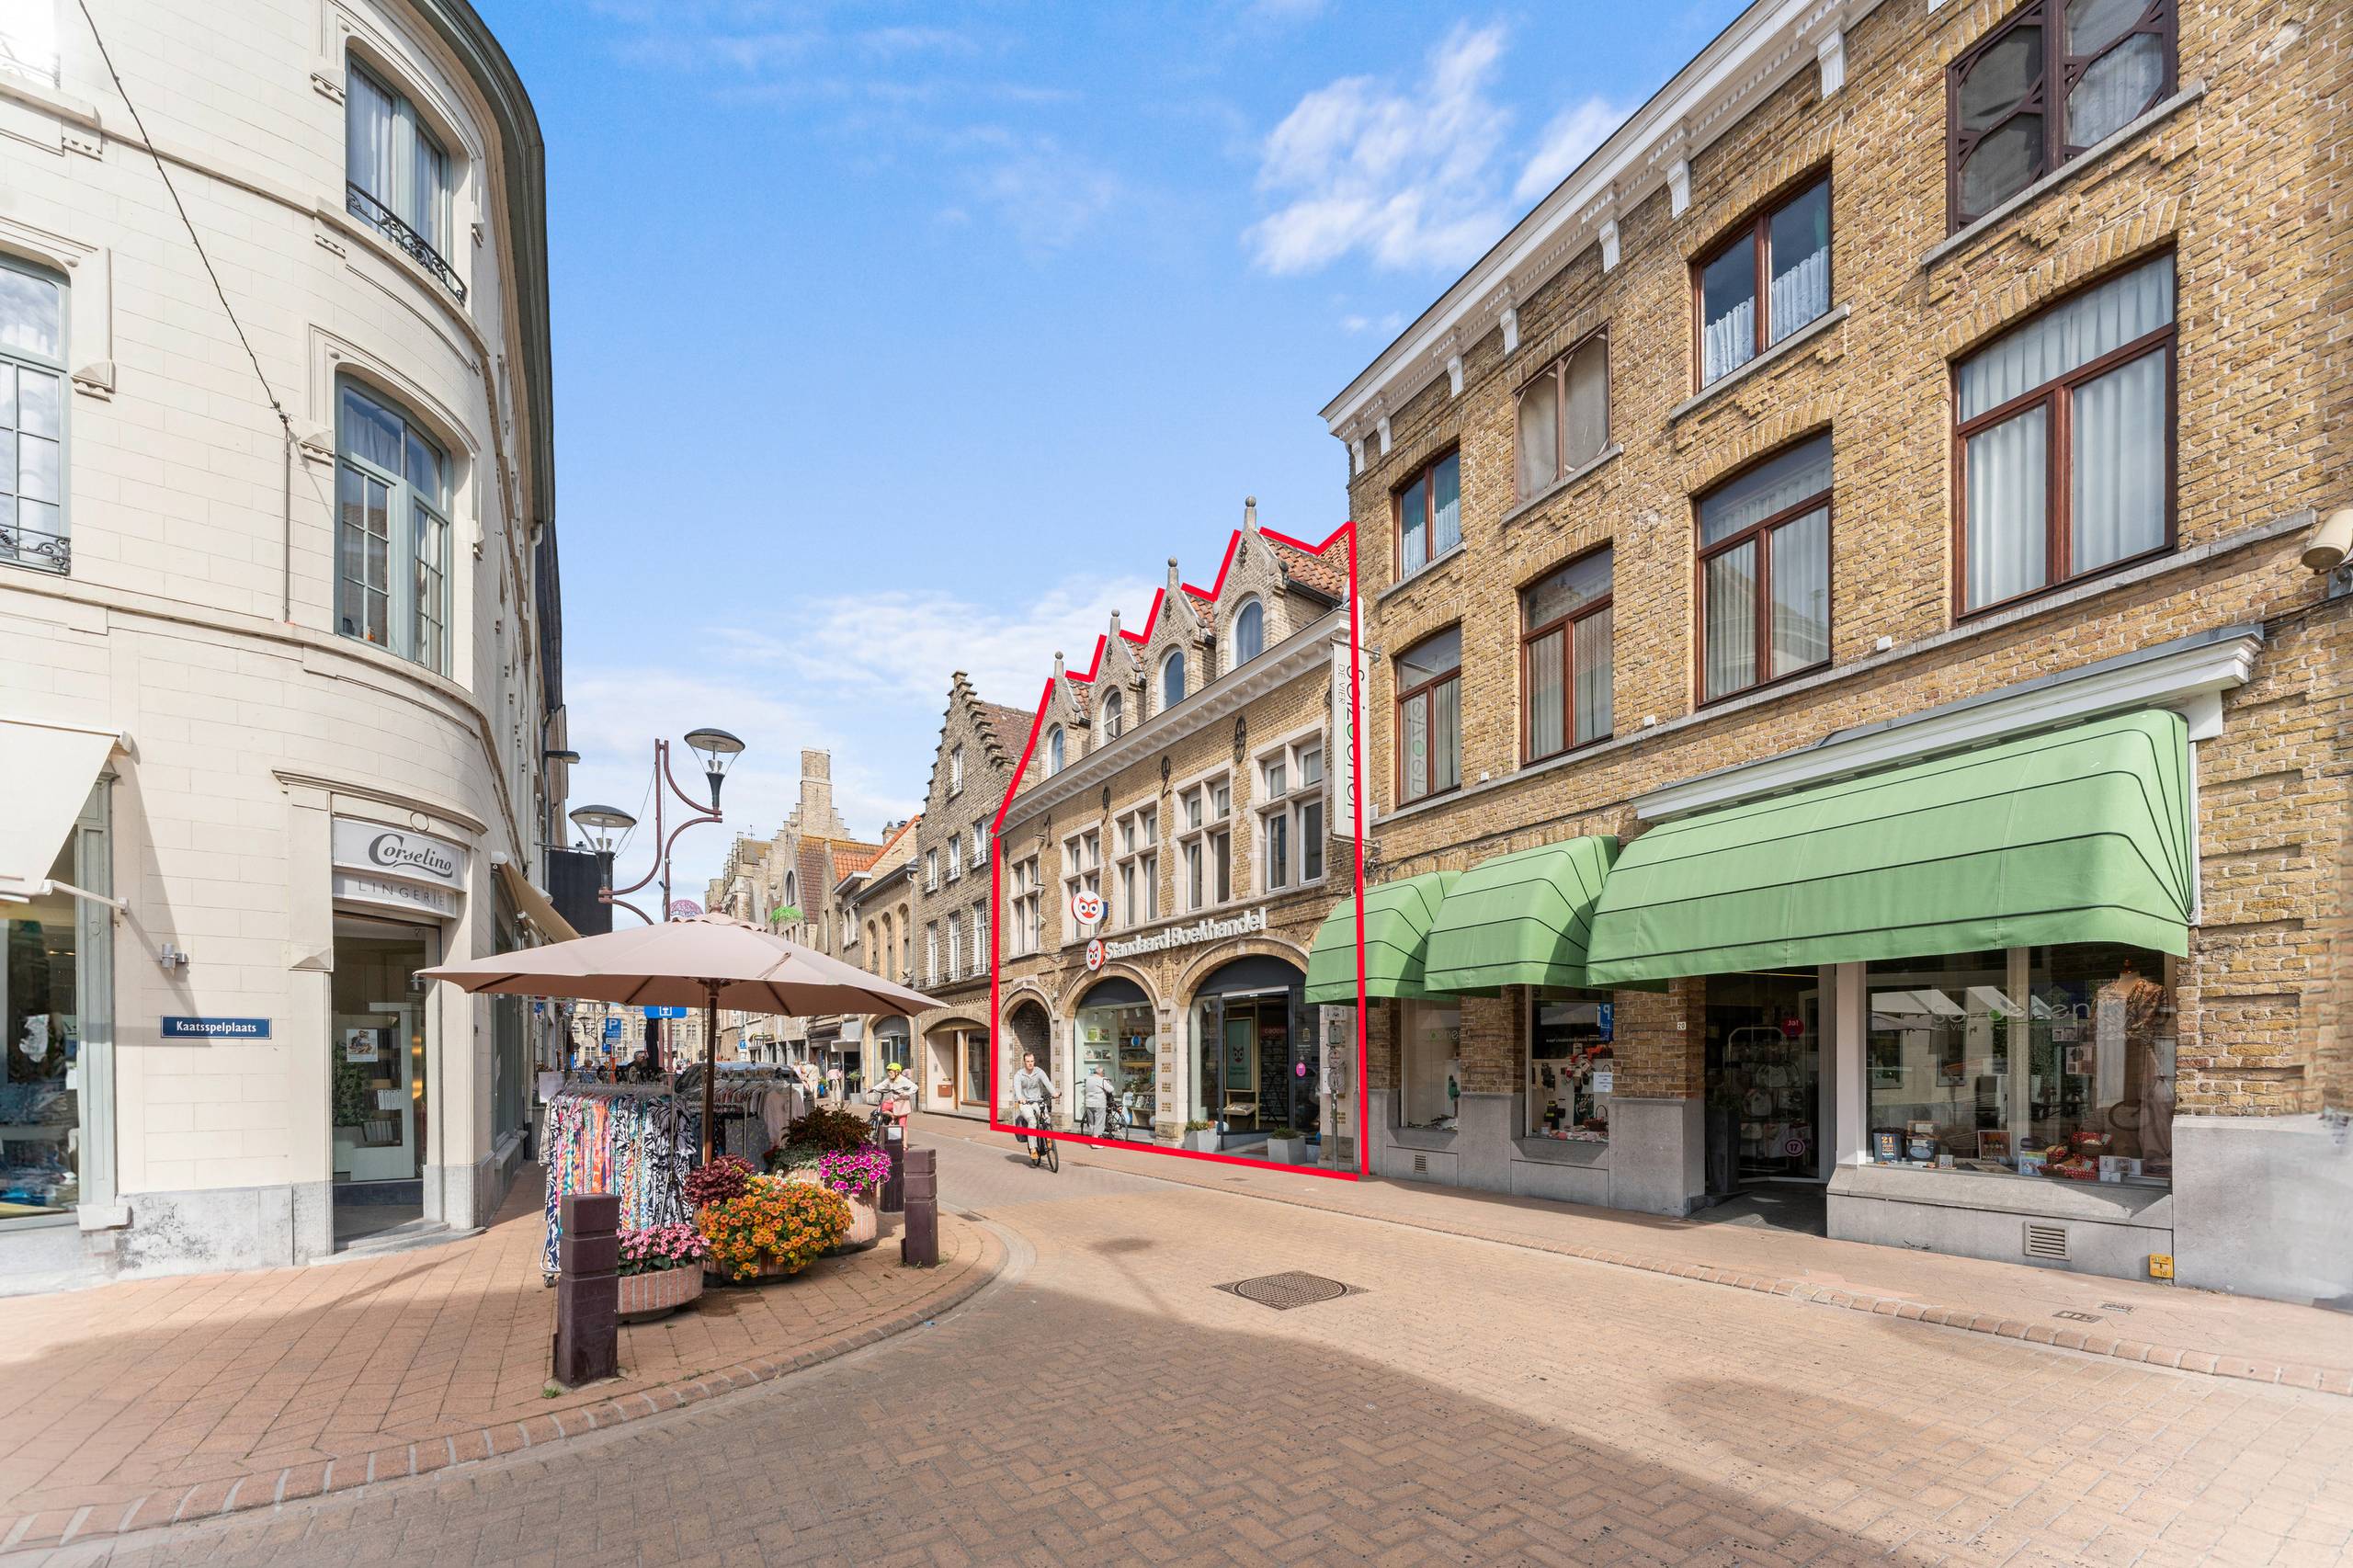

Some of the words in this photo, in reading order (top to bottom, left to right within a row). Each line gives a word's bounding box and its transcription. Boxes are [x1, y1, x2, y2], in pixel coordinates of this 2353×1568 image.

[1337, 664, 1345, 679] DE
[369, 834, 453, 878] Corselino
[358, 881, 445, 906] LINGERIE
[1105, 928, 1170, 960] Standaard
[1170, 906, 1267, 946] Boekhandel
[176, 1021, 256, 1034] Kaatsspelplaats
[608, 1019, 618, 1029] P
